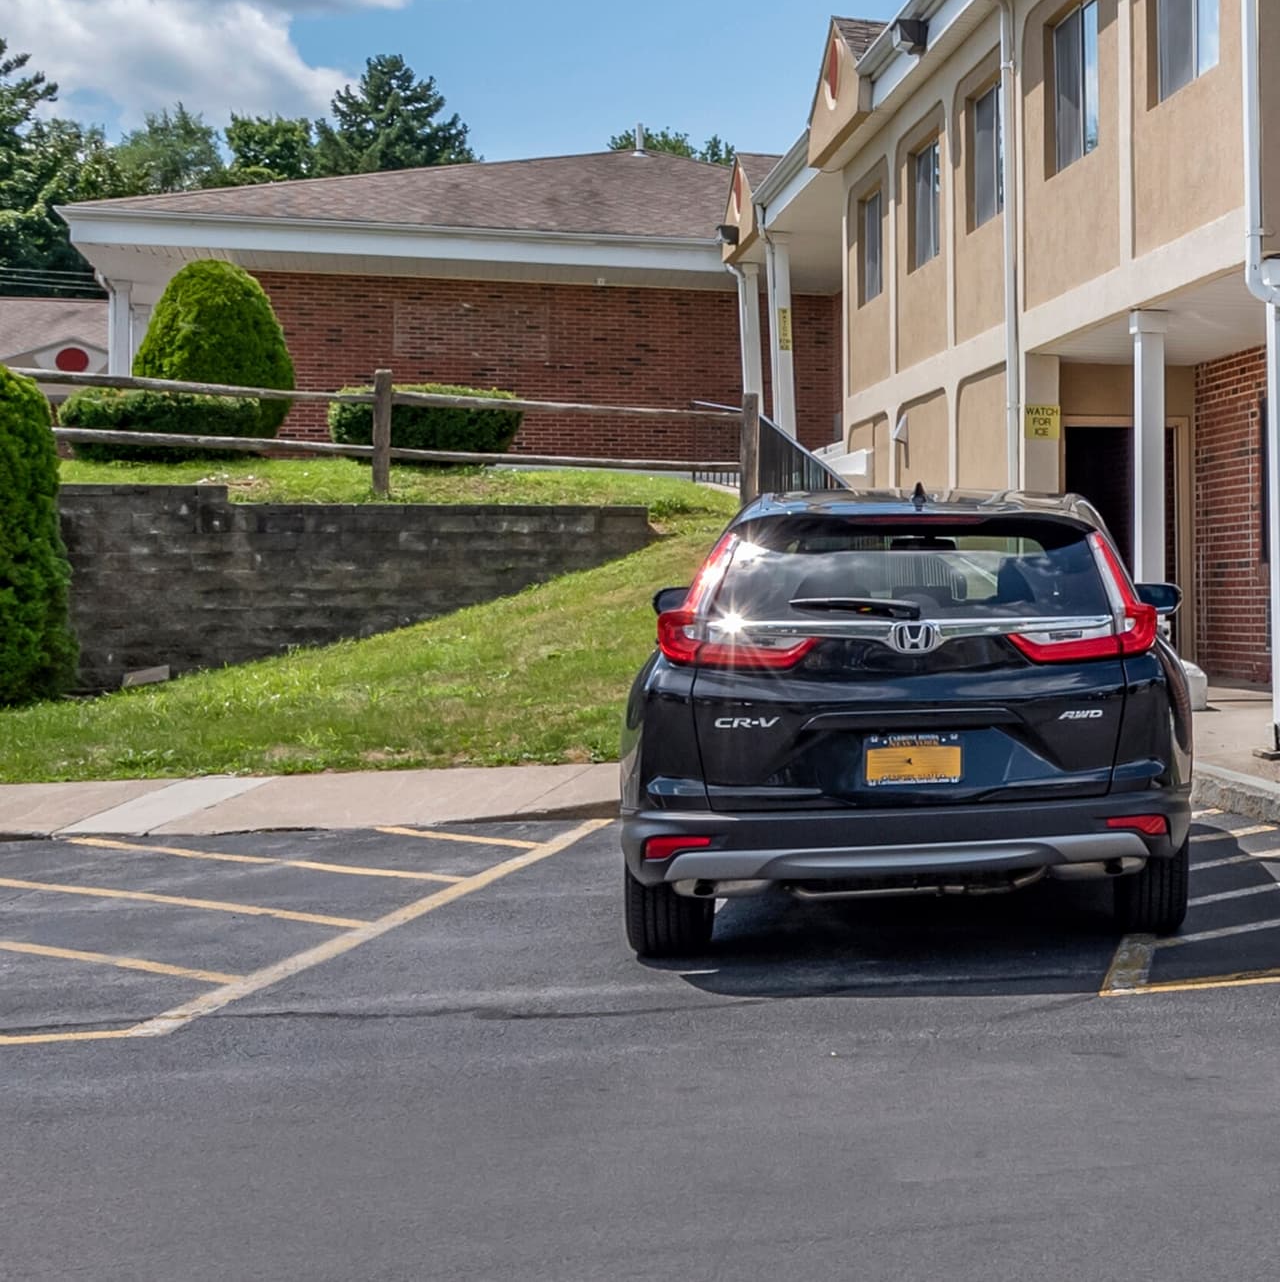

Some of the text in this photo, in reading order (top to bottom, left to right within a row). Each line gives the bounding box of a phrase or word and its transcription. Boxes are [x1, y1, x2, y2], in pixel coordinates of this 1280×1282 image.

[1025, 407, 1058, 416] WATCH
[1032, 417, 1051, 426] FOR
[1034, 427, 1049, 436] ICE
[1058, 709, 1103, 720] AWD
[714, 716, 780, 729] CR-V
